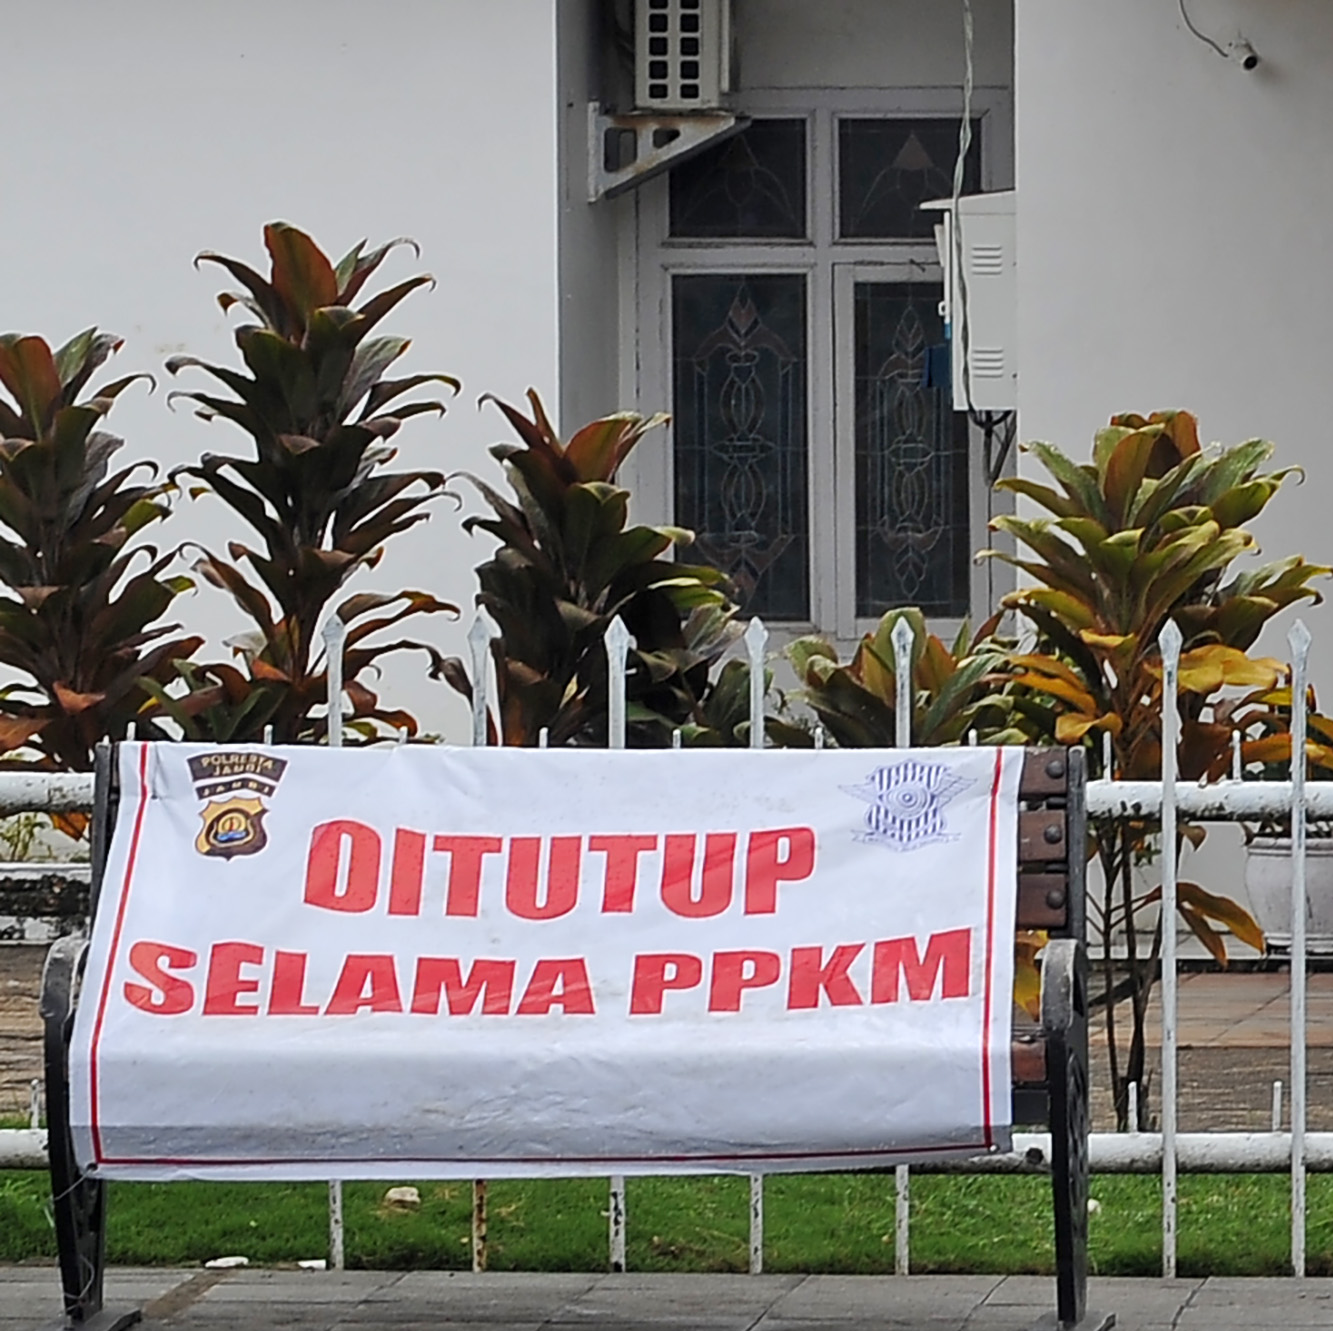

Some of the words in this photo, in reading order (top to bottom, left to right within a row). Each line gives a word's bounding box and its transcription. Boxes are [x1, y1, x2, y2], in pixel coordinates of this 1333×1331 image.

[201, 755, 273, 769] POLRESTA
[214, 765, 261, 775] JAMBI
[203, 782, 269, 796] JAMBI
[303, 819, 817, 921] DITUTUP
[123, 939, 596, 1017] SELAMA
[630, 927, 973, 1017] PPKM
